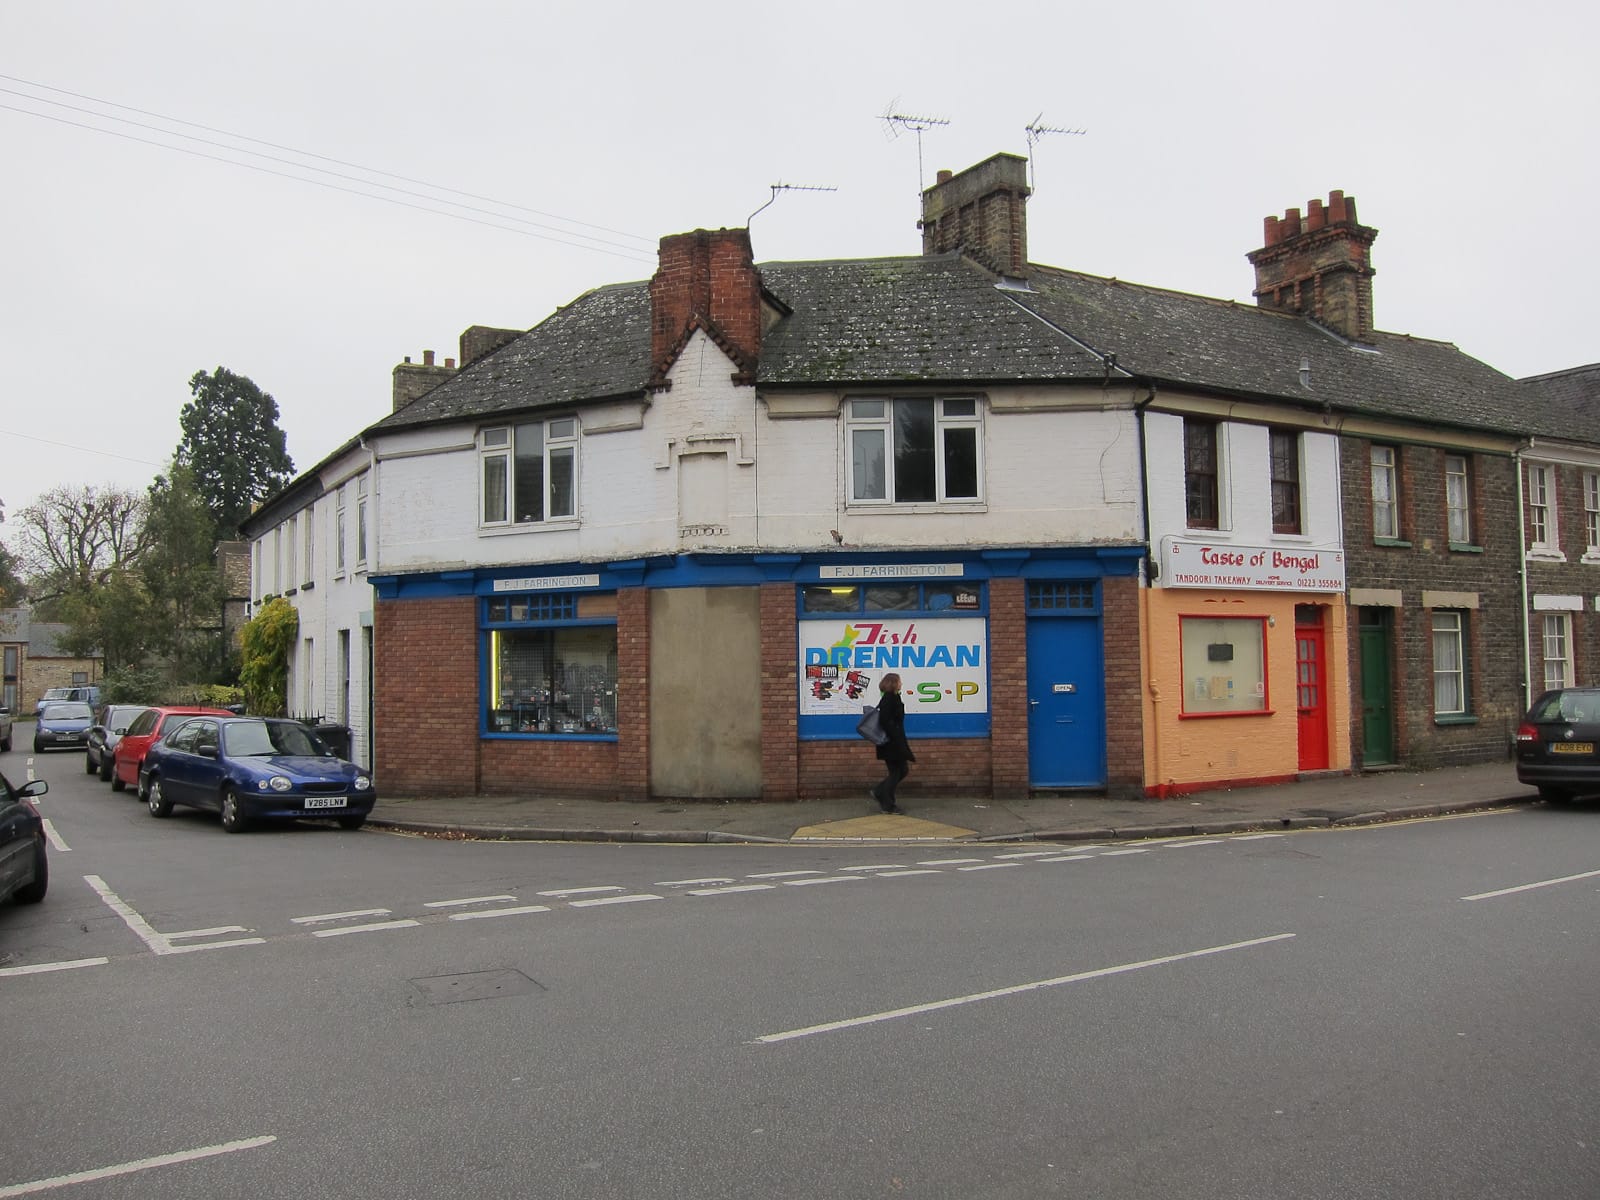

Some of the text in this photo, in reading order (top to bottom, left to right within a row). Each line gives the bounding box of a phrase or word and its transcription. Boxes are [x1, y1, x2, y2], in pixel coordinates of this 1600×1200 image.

[1200, 547, 1319, 574] Taste of Bengal
[863, 565, 946, 577] FARRINGTON
[524, 576, 586, 589] FARRINGTON
[1175, 574, 1251, 585] TANDOORI TAKEAWAY
[1297, 578, 1316, 587] 01223
[805, 644, 981, 669] DRENNAN
[308, 798, 345, 807] V285 LNW
